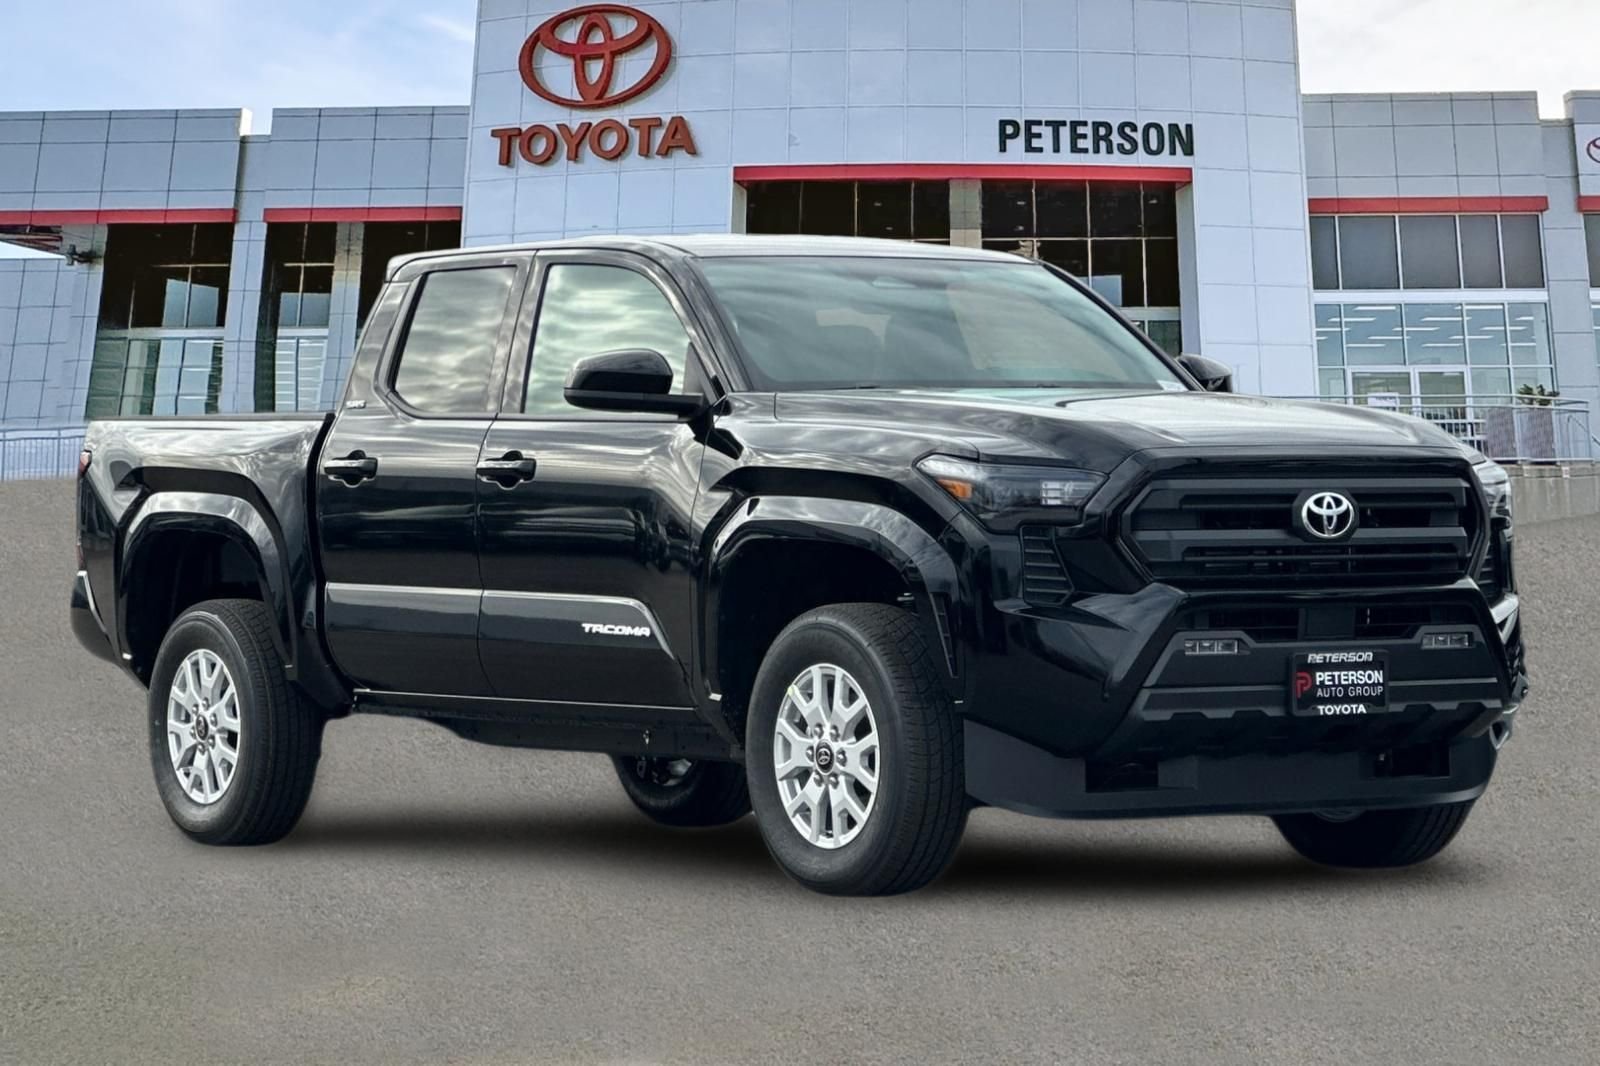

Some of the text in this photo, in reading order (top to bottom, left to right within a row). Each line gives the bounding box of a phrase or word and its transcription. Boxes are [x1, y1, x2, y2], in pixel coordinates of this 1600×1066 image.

[490, 115, 697, 166] TOYOTA
[998, 119, 1194, 157] PETERSON
[581, 623, 650, 637] TACOMA
[1307, 651, 1373, 663] PETERSON
[1315, 670, 1383, 685] PETERSON
[1316, 686, 1383, 697] AUTO GROUP
[1317, 704, 1366, 715] TOYOTA
